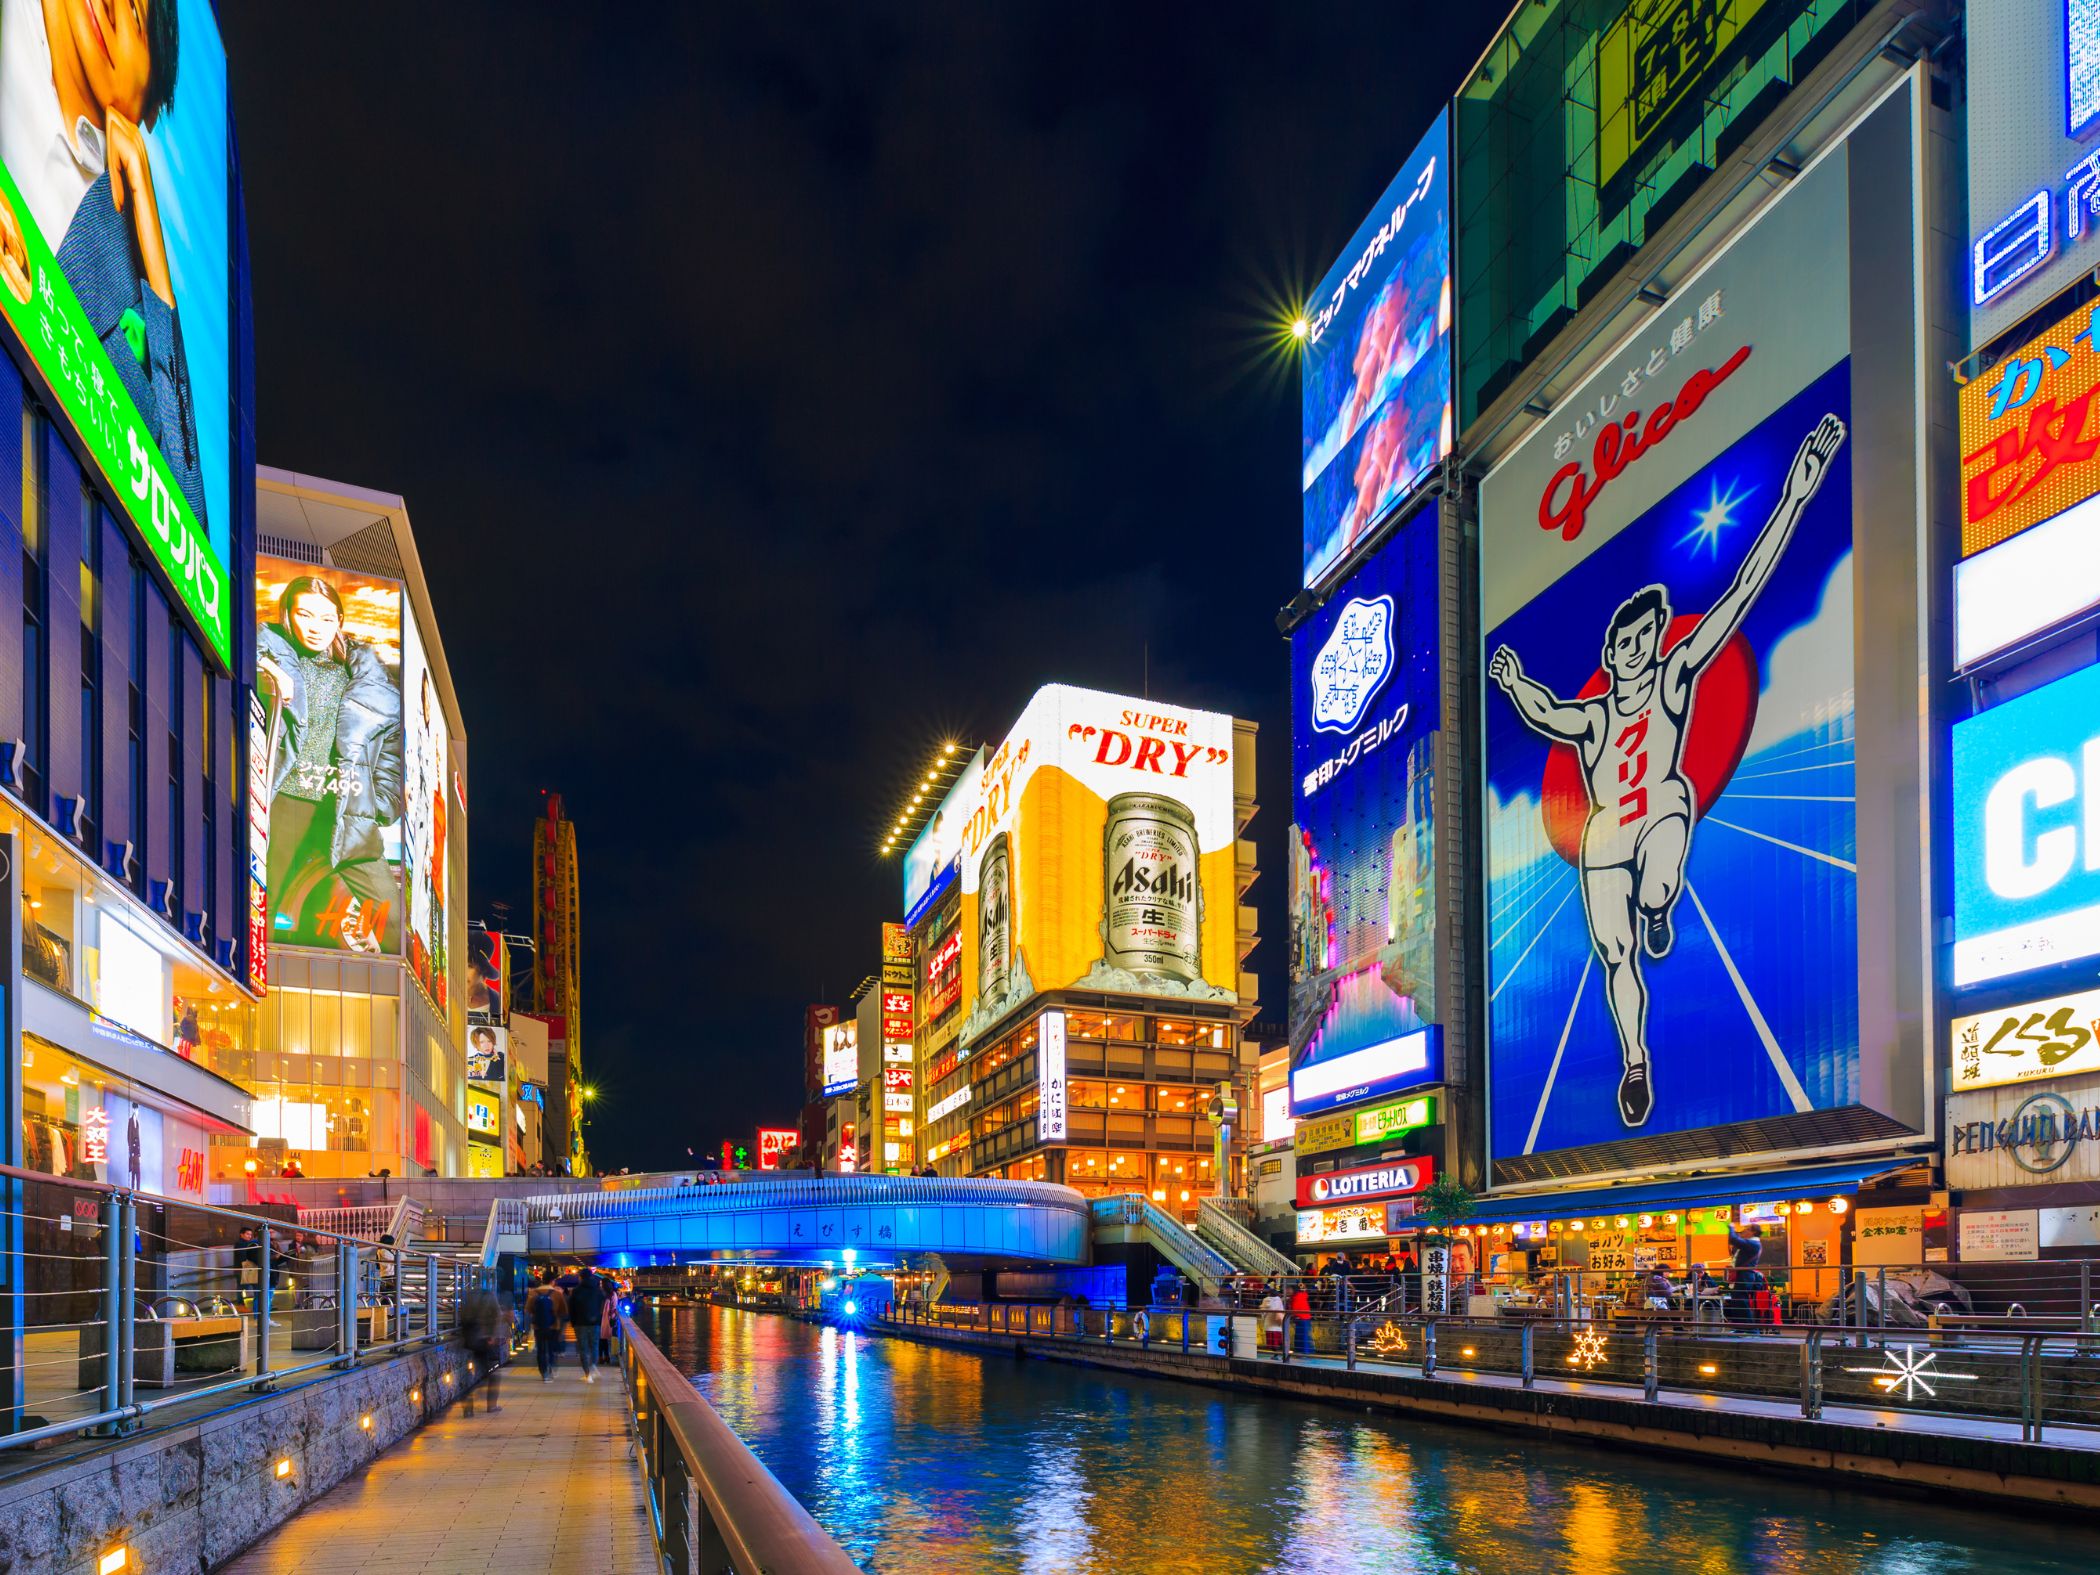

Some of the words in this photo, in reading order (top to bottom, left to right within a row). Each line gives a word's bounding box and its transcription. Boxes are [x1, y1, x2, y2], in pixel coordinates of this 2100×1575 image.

[1311, 155, 1437, 345] ピップマグネループ
[1553, 289, 1725, 461] おいしさと健康
[1538, 345, 1752, 542] Glico
[127, 425, 222, 634] サロンパス
[1120, 710, 1188, 737] SUPER
[299, 761, 360, 780] ジャケット
[980, 741, 1010, 796] SUPER
[1303, 703, 1408, 797] 雪印メグミルク
[1614, 708, 1652, 828] グリコ
[1985, 735, 2100, 900] C
[1113, 857, 1191, 903] Asahi
[1131, 928, 1177, 940] スーパードライ
[1142, 908, 1165, 926] 生
[1144, 954, 1164, 964] 350ml
[1961, 1022, 1980, 1079] 道頓堀
[1982, 1007, 2092, 1066] くくる
[2017, 1066, 2055, 1078] KUKURU
[1331, 1168, 1408, 1195] LOTTERIA
[793, 1223, 892, 1239] えびす橋
[1592, 1253, 1626, 1270] お好み
